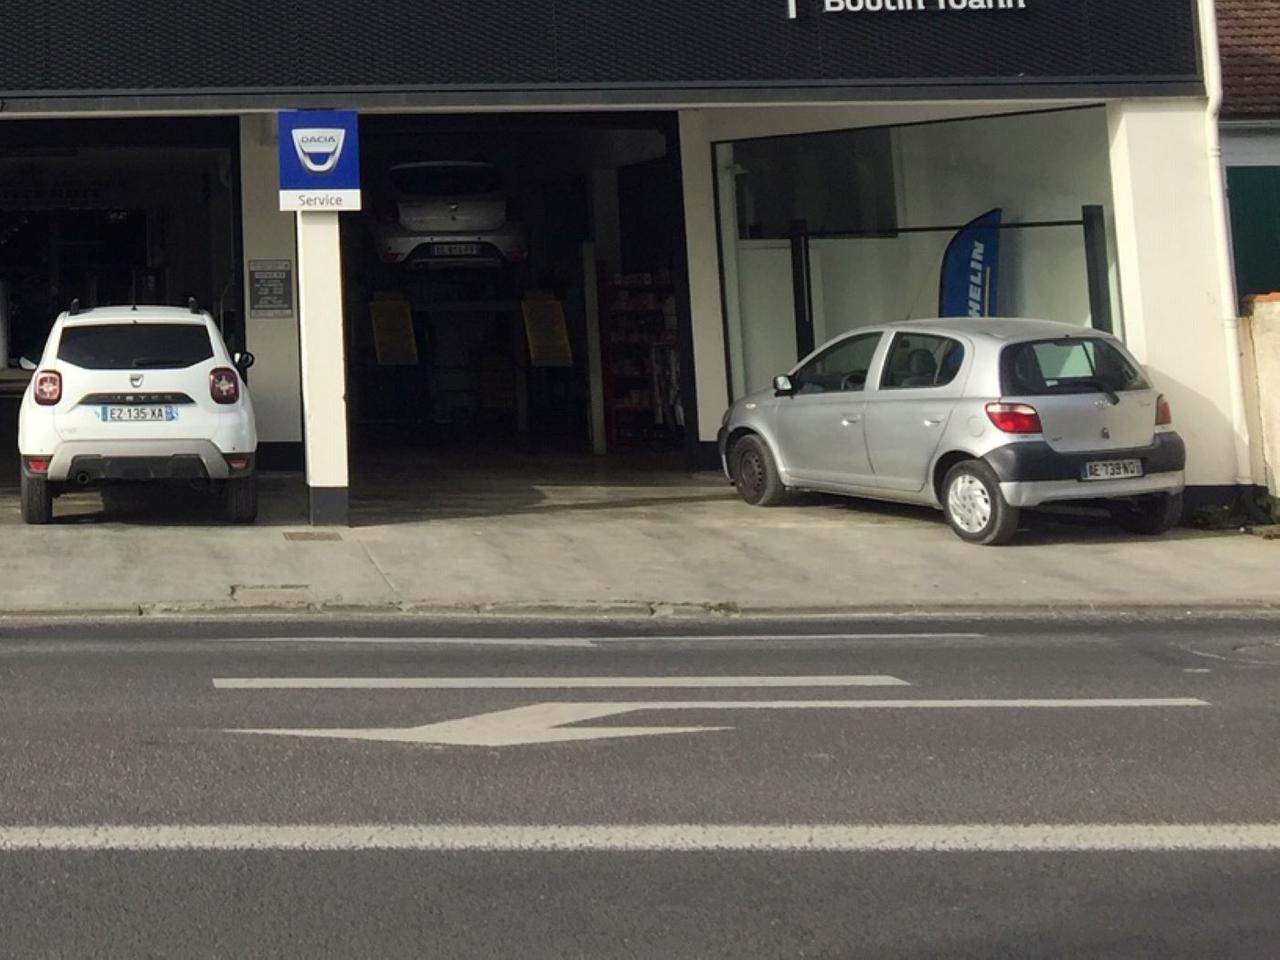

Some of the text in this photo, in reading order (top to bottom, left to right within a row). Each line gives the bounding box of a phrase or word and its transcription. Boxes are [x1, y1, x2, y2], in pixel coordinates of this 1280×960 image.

[301, 135, 336, 144] DACIA
[298, 194, 343, 206] Service
[967, 240, 985, 318] HELIN
